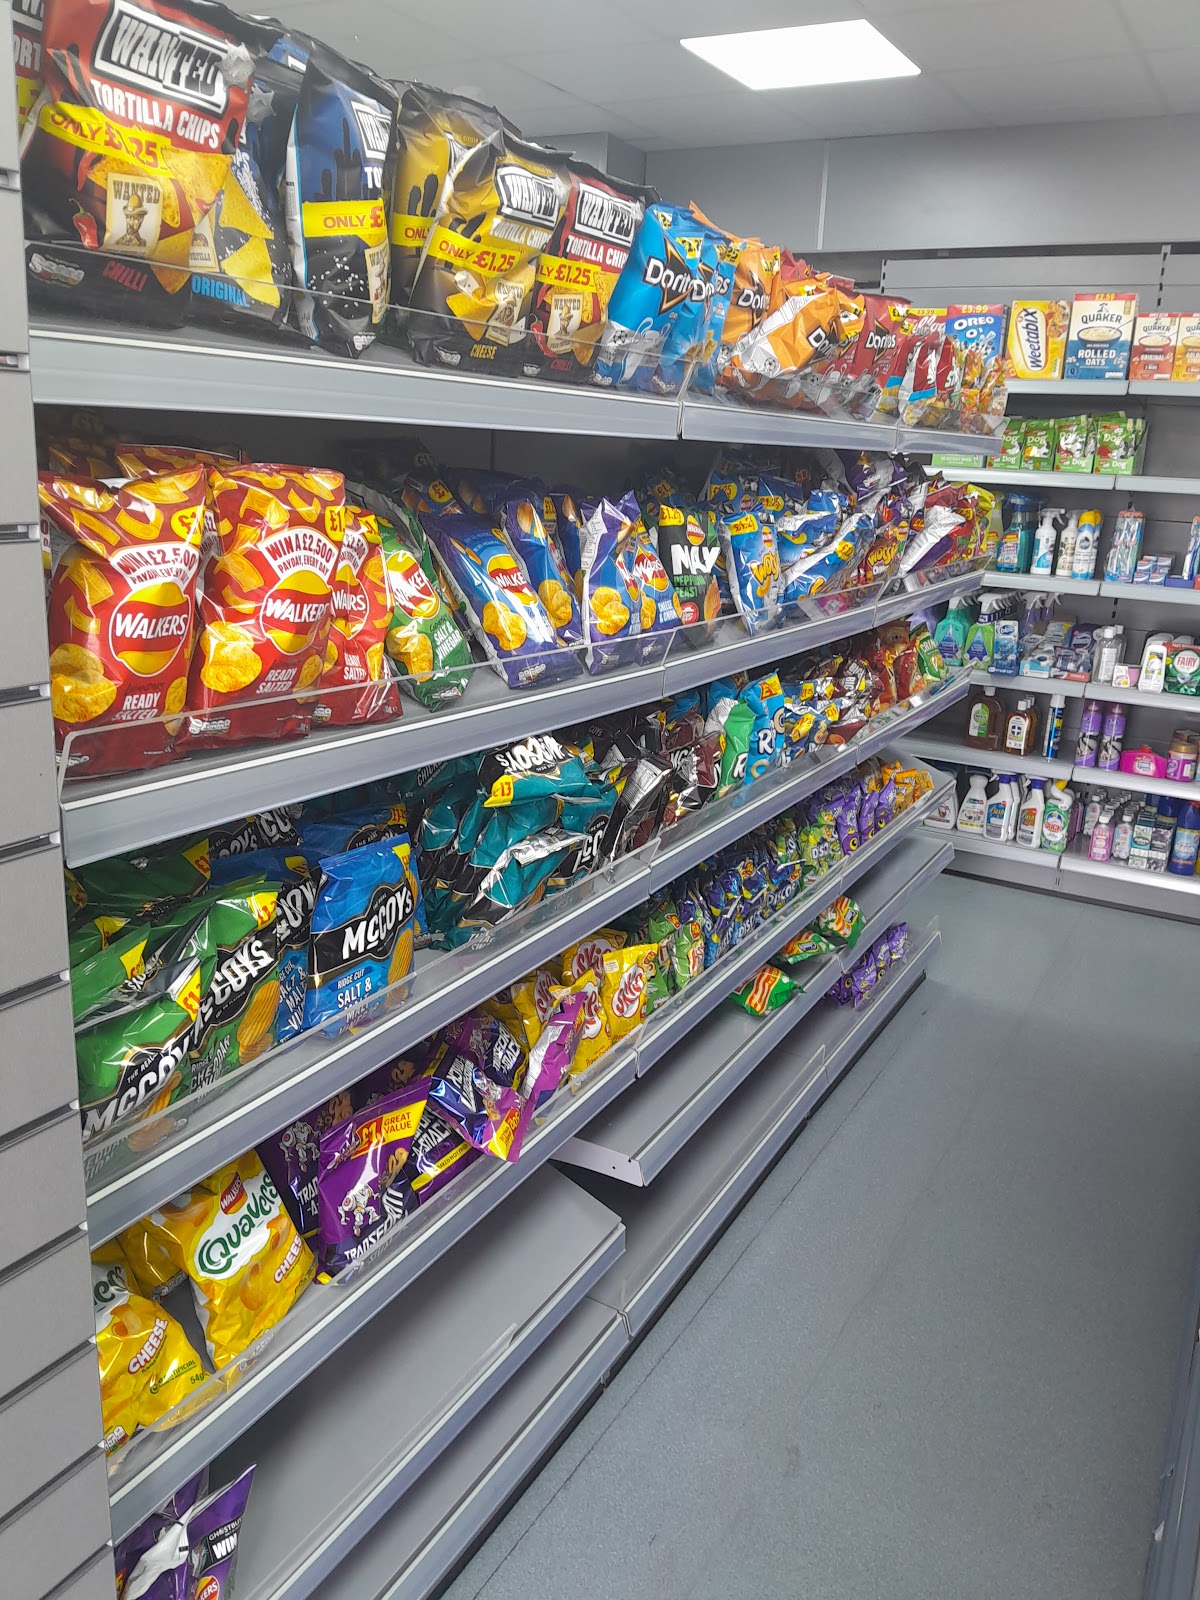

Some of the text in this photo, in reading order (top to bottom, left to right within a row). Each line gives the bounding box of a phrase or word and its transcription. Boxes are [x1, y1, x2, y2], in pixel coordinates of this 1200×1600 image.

[110, 14, 224, 97] WANTED
[90, 78, 219, 149] TORTILLA CHIPS
[50, 112, 102, 142] ONLY
[112, 180, 161, 204] WANTED
[504, 174, 557, 217] WANTED
[323, 215, 367, 229] ONLY
[580, 191, 635, 236] WANTED
[489, 218, 526, 244] TORTILLA
[438, 240, 516, 273] ONLY £1.25
[565, 234, 628, 269] TORTILLA CHIP
[102, 260, 148, 292] CHILLI
[554, 263, 591, 286] £1.25
[645, 258, 693, 295] Dorit
[191, 275, 250, 307] ORIGINAL
[961, 305, 988, 314] £3.99
[1081, 313, 1123, 324] QUAKER
[953, 316, 994, 331] OREO
[1143, 325, 1171, 333] QUAKER
[1022, 307, 1042, 368] Weetabix
[470, 344, 497, 360] CHEESE
[1078, 349, 1116, 359] ROLLED
[1085, 358, 1106, 366] OATS
[265, 533, 334, 563] WIN A £2,500
[277, 555, 330, 577] PAYDAY, EVERY DAY
[494, 571, 526, 589] WALKE
[114, 612, 188, 639] WALKERS
[433, 622, 448, 645] SALT
[445, 621, 454, 632] &
[435, 631, 463, 661] VINEGAR
[343, 666, 367, 681] SALTED
[1177, 656, 1197, 668] FAIRY
[256, 681, 292, 694] SALTED
[265, 668, 297, 682] READY
[123, 692, 161, 711] READY
[338, 968, 366, 989] RIDGE CUT
[337, 977, 372, 1008] SALT &
[126, 1053, 158, 1084] THE REAL
[383, 1121, 412, 1135] VALUE
[384, 1111, 412, 1126] GREAT
[220, 1177, 243, 1210] WALKERS
[198, 1173, 279, 1275] Quavers
[274, 1234, 302, 1283] CHEES
[127, 1317, 169, 1375] CHEESE
[190, 1373, 205, 1385] 54g
[212, 1532, 238, 1560] WIN
